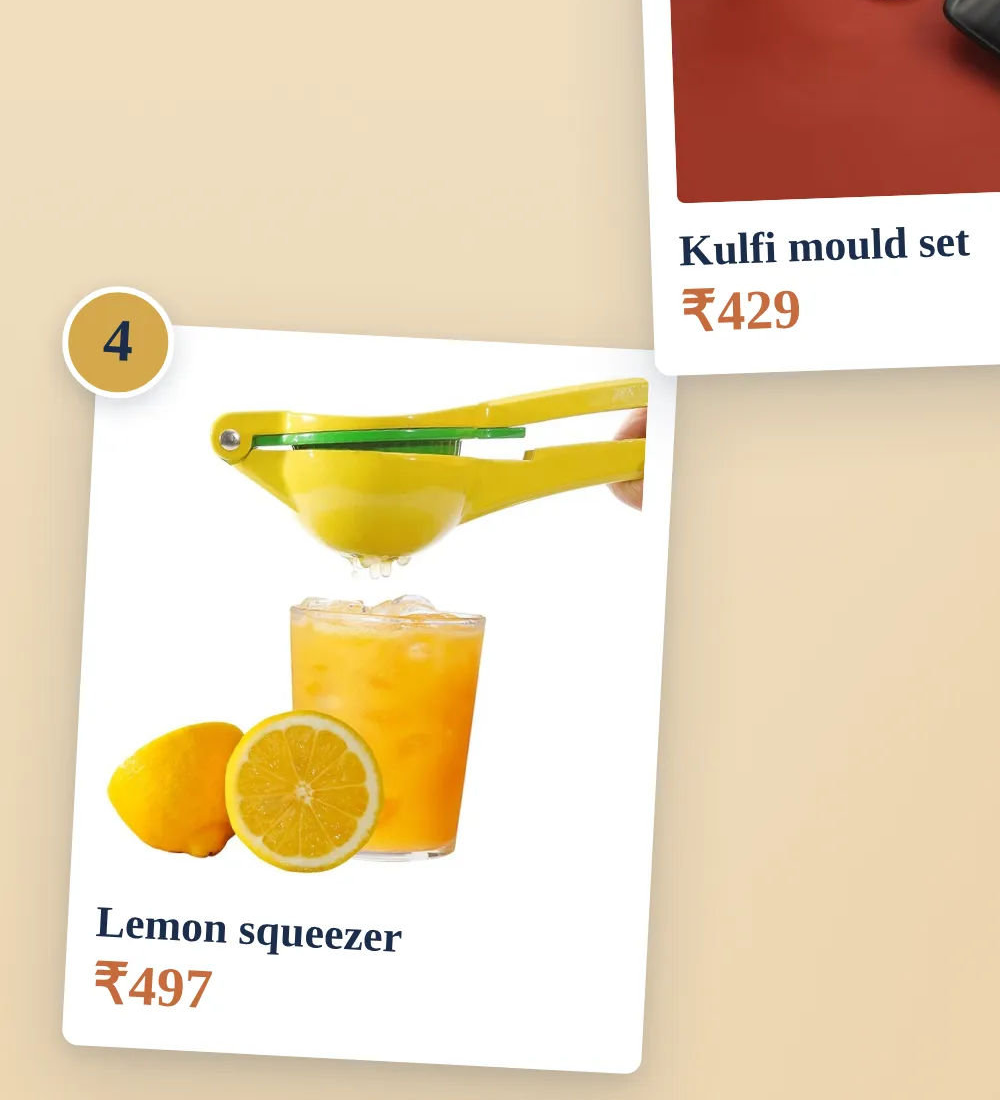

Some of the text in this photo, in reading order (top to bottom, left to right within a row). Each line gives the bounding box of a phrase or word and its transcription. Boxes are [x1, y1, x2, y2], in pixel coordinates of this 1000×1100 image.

[678, 226, 971, 266] Kulfi mould set
[682, 287, 801, 332] ₹429
[103, 320, 133, 362] 4
[95, 906, 403, 956] Lemon squeezer
[94, 960, 213, 1008] ₹497
